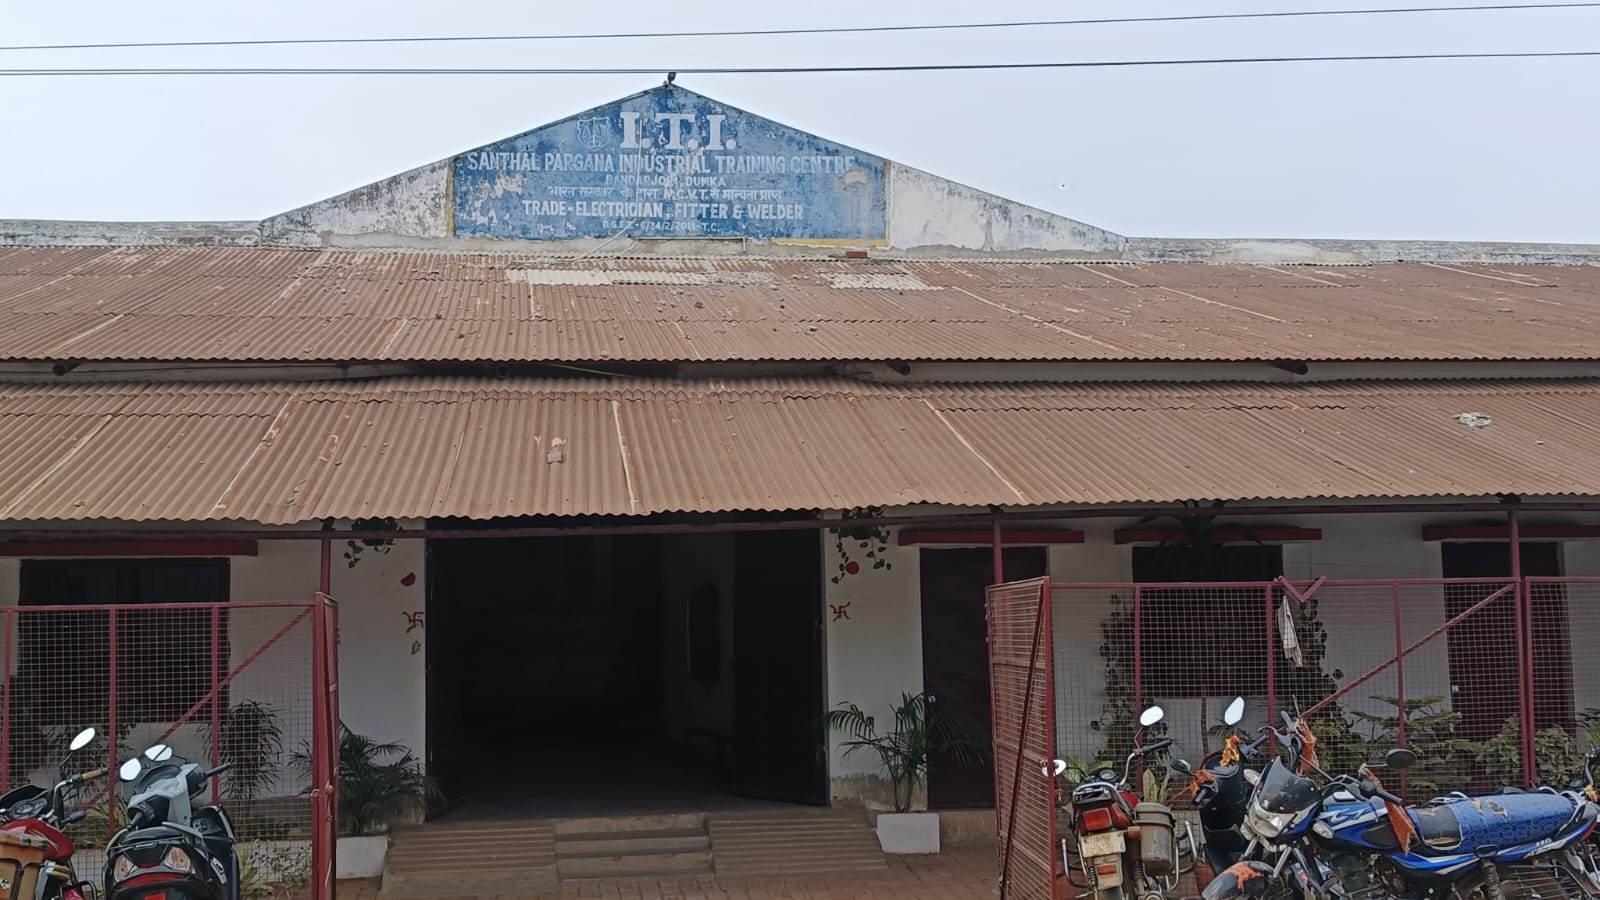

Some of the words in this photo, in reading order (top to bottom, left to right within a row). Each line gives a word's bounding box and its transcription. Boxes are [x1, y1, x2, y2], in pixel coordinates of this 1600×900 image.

[619, 111, 737, 150] I.T.I.
[467, 152, 540, 171] SANTHAL
[544, 153, 614, 172] PARGANA
[619, 154, 710, 174] INDUSTRIAL
[715, 155, 785, 174] TRAINING
[790, 155, 855, 174] CENTRE
[686, 175, 726, 187] DUMKA
[547, 186, 578, 198] भारत
[722, 188, 759, 201] मान्यता
[674, 202, 728, 219] FITTER
[733, 203, 745, 219] &
[747, 203, 804, 220] WELDER
